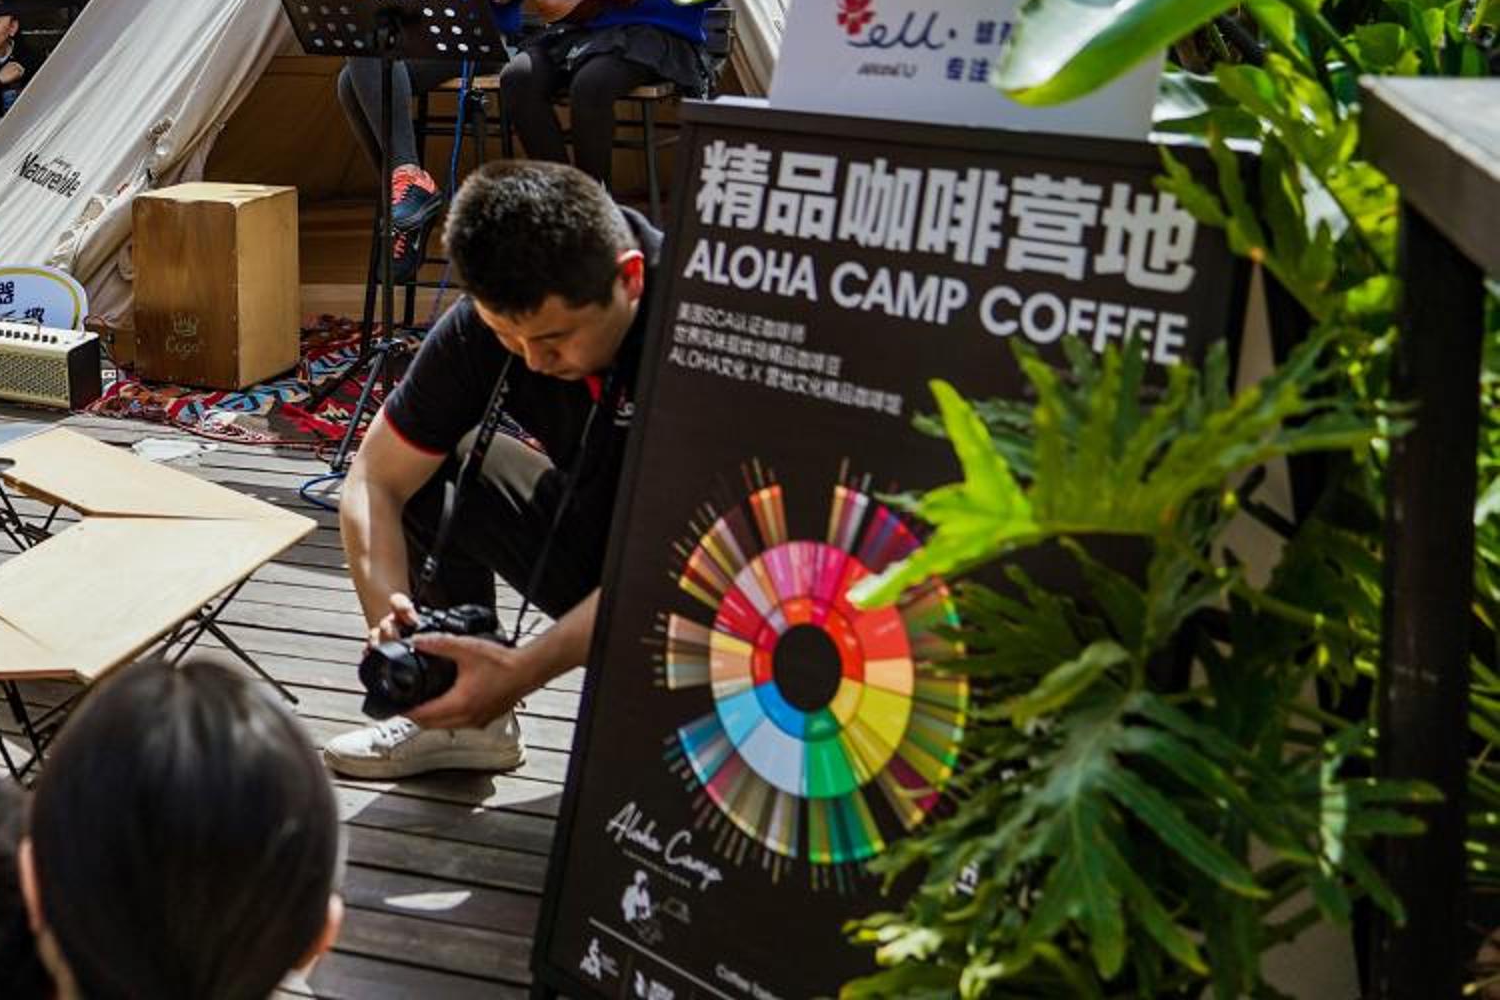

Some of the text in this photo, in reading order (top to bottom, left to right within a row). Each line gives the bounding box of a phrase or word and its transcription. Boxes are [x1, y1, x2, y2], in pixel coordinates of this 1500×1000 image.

[695, 139, 1197, 294] 精品咖啡营地
[683, 237, 1189, 366] ALOHA CAMP COFFEE
